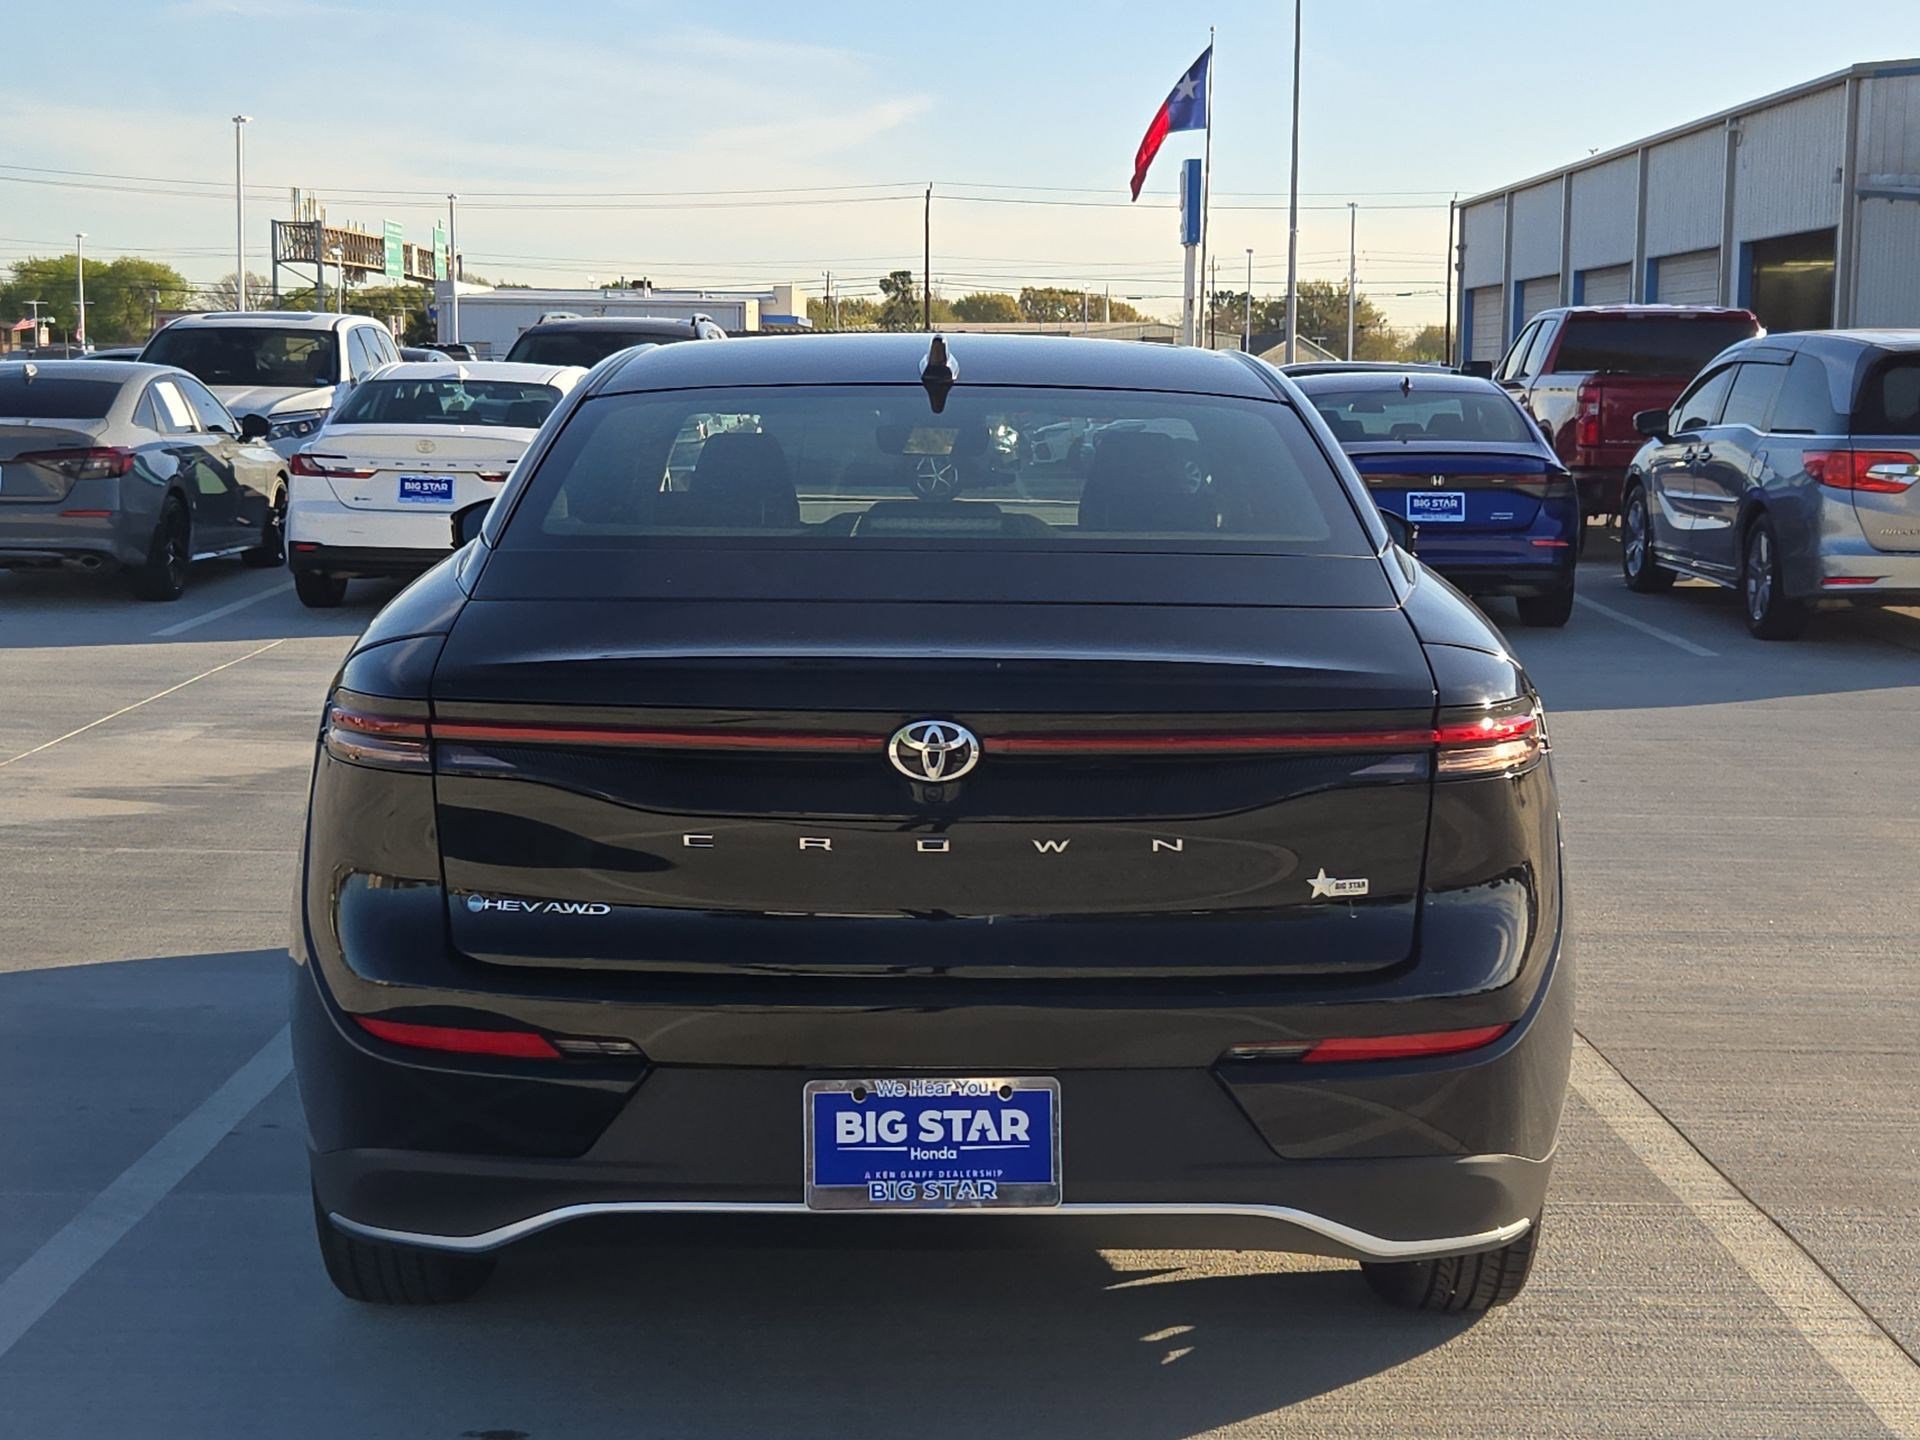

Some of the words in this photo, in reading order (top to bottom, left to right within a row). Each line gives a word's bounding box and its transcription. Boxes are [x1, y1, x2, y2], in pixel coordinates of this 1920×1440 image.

[404, 481, 421, 490] BIG
[422, 482, 449, 491] STAR
[1413, 498, 1431, 508] BIG
[1432, 498, 1458, 508] STAR
[682, 833, 1184, 854] CROWN
[1335, 882, 1347, 890] BIG
[1348, 881, 1366, 889] STAR
[543, 902, 611, 915] AWD
[875, 1080, 906, 1097] We
[909, 1080, 952, 1097] Hear
[953, 1079, 991, 1096] You
[836, 1110, 908, 1144] BIG
[918, 1109, 1030, 1142] STAR
[910, 1146, 958, 1160] Honda
[864, 1171, 871, 1180] A
[875, 1171, 896, 1179] KEN
[900, 1170, 934, 1179] GARFF
[938, 1169, 1004, 1179] DEALERSHIP
[868, 1180, 916, 1202] BIG
[922, 1179, 998, 1201] STAR
